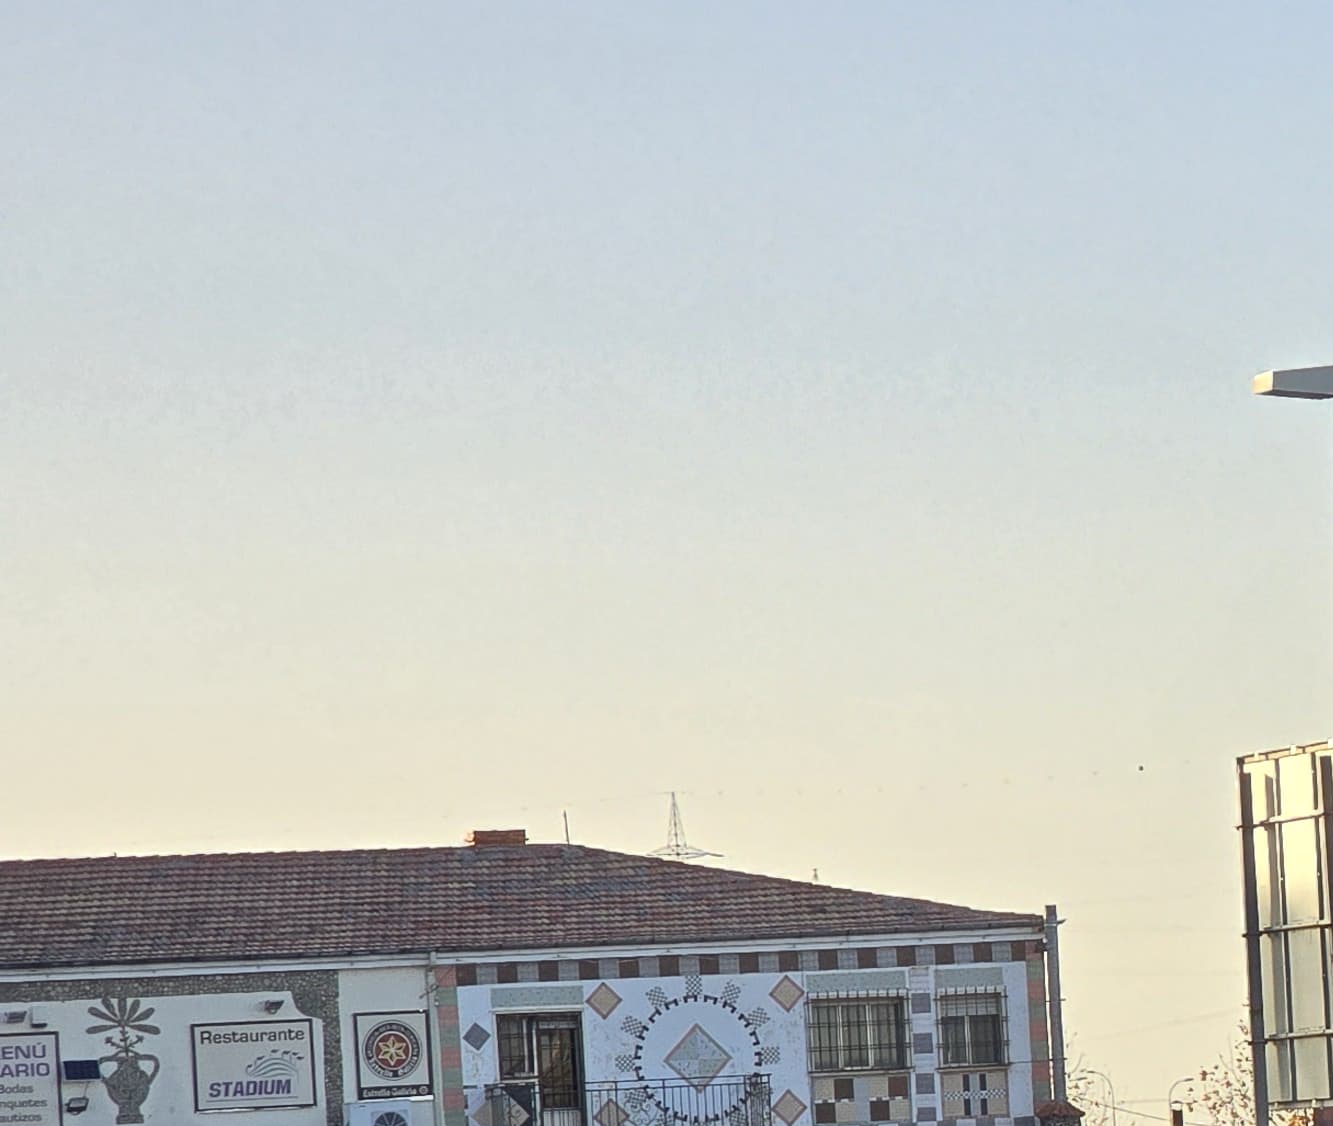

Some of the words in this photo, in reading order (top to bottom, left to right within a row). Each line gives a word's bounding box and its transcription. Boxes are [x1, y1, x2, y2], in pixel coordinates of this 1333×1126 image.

[200, 1028, 305, 1045] Restaurante
[1, 1041, 47, 1060] ENÚ
[0, 1062, 50, 1078] ARIO
[208, 1079, 292, 1098] STADIUM
[0, 1099, 48, 1111] nquetes
[0, 1112, 42, 1122] autizos
